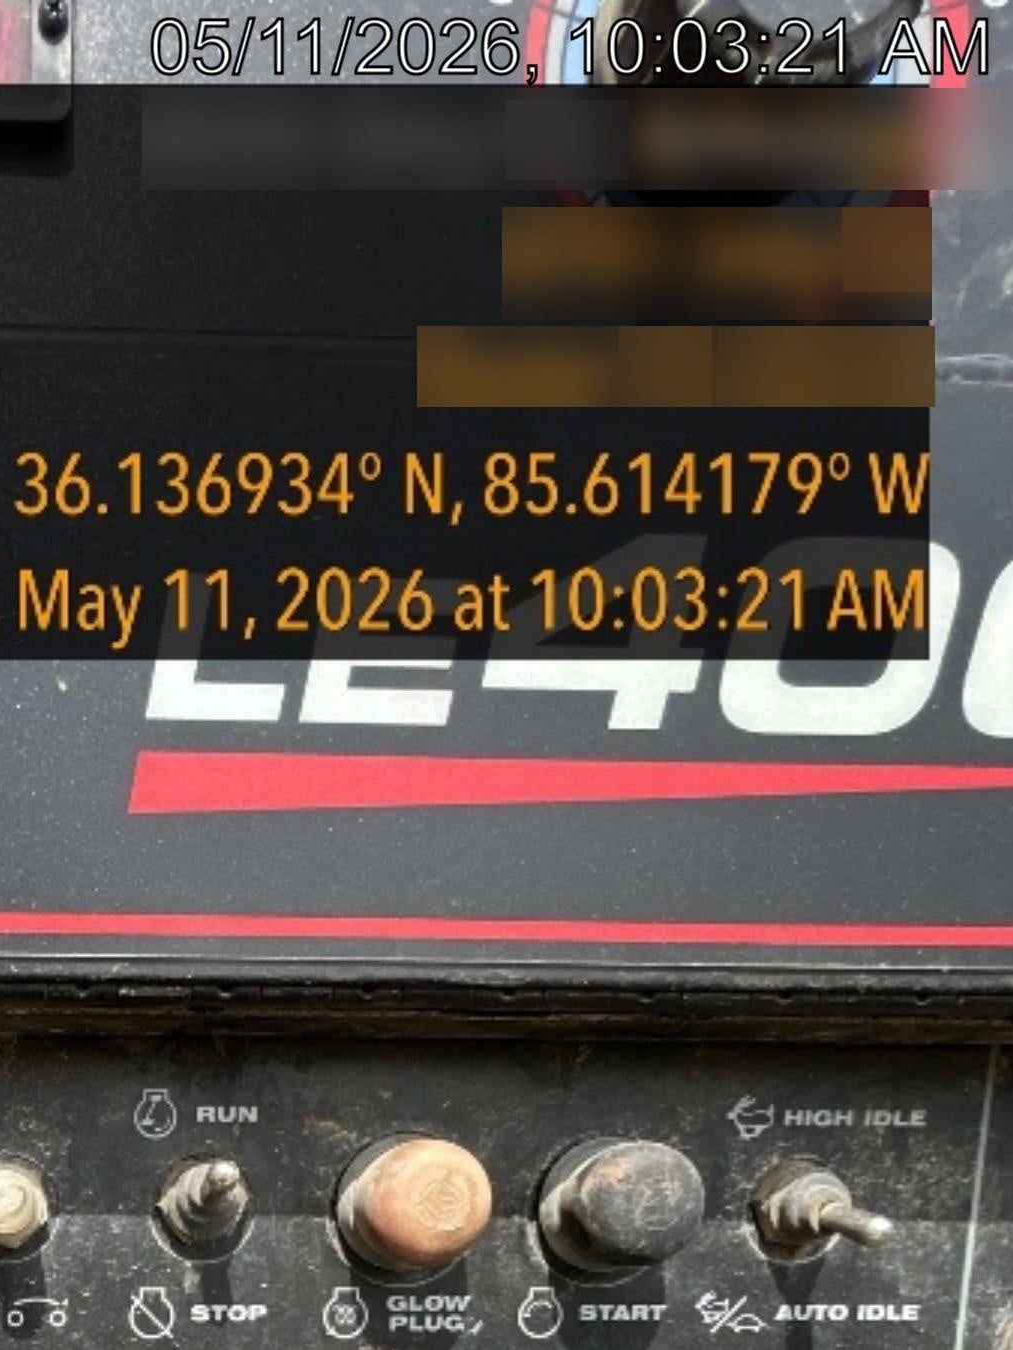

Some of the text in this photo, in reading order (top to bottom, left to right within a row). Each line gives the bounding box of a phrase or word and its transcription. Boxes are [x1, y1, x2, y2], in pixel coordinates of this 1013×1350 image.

[196, 1105, 259, 1124] RUN
[784, 1109, 927, 1127] HIGH IDLE
[386, 1295, 471, 1312] GLOW
[579, 1303, 667, 1321] START
[774, 1303, 921, 1322] AUTO IDLE
[191, 1304, 267, 1322] STOP
[389, 1314, 465, 1333] PLUG
